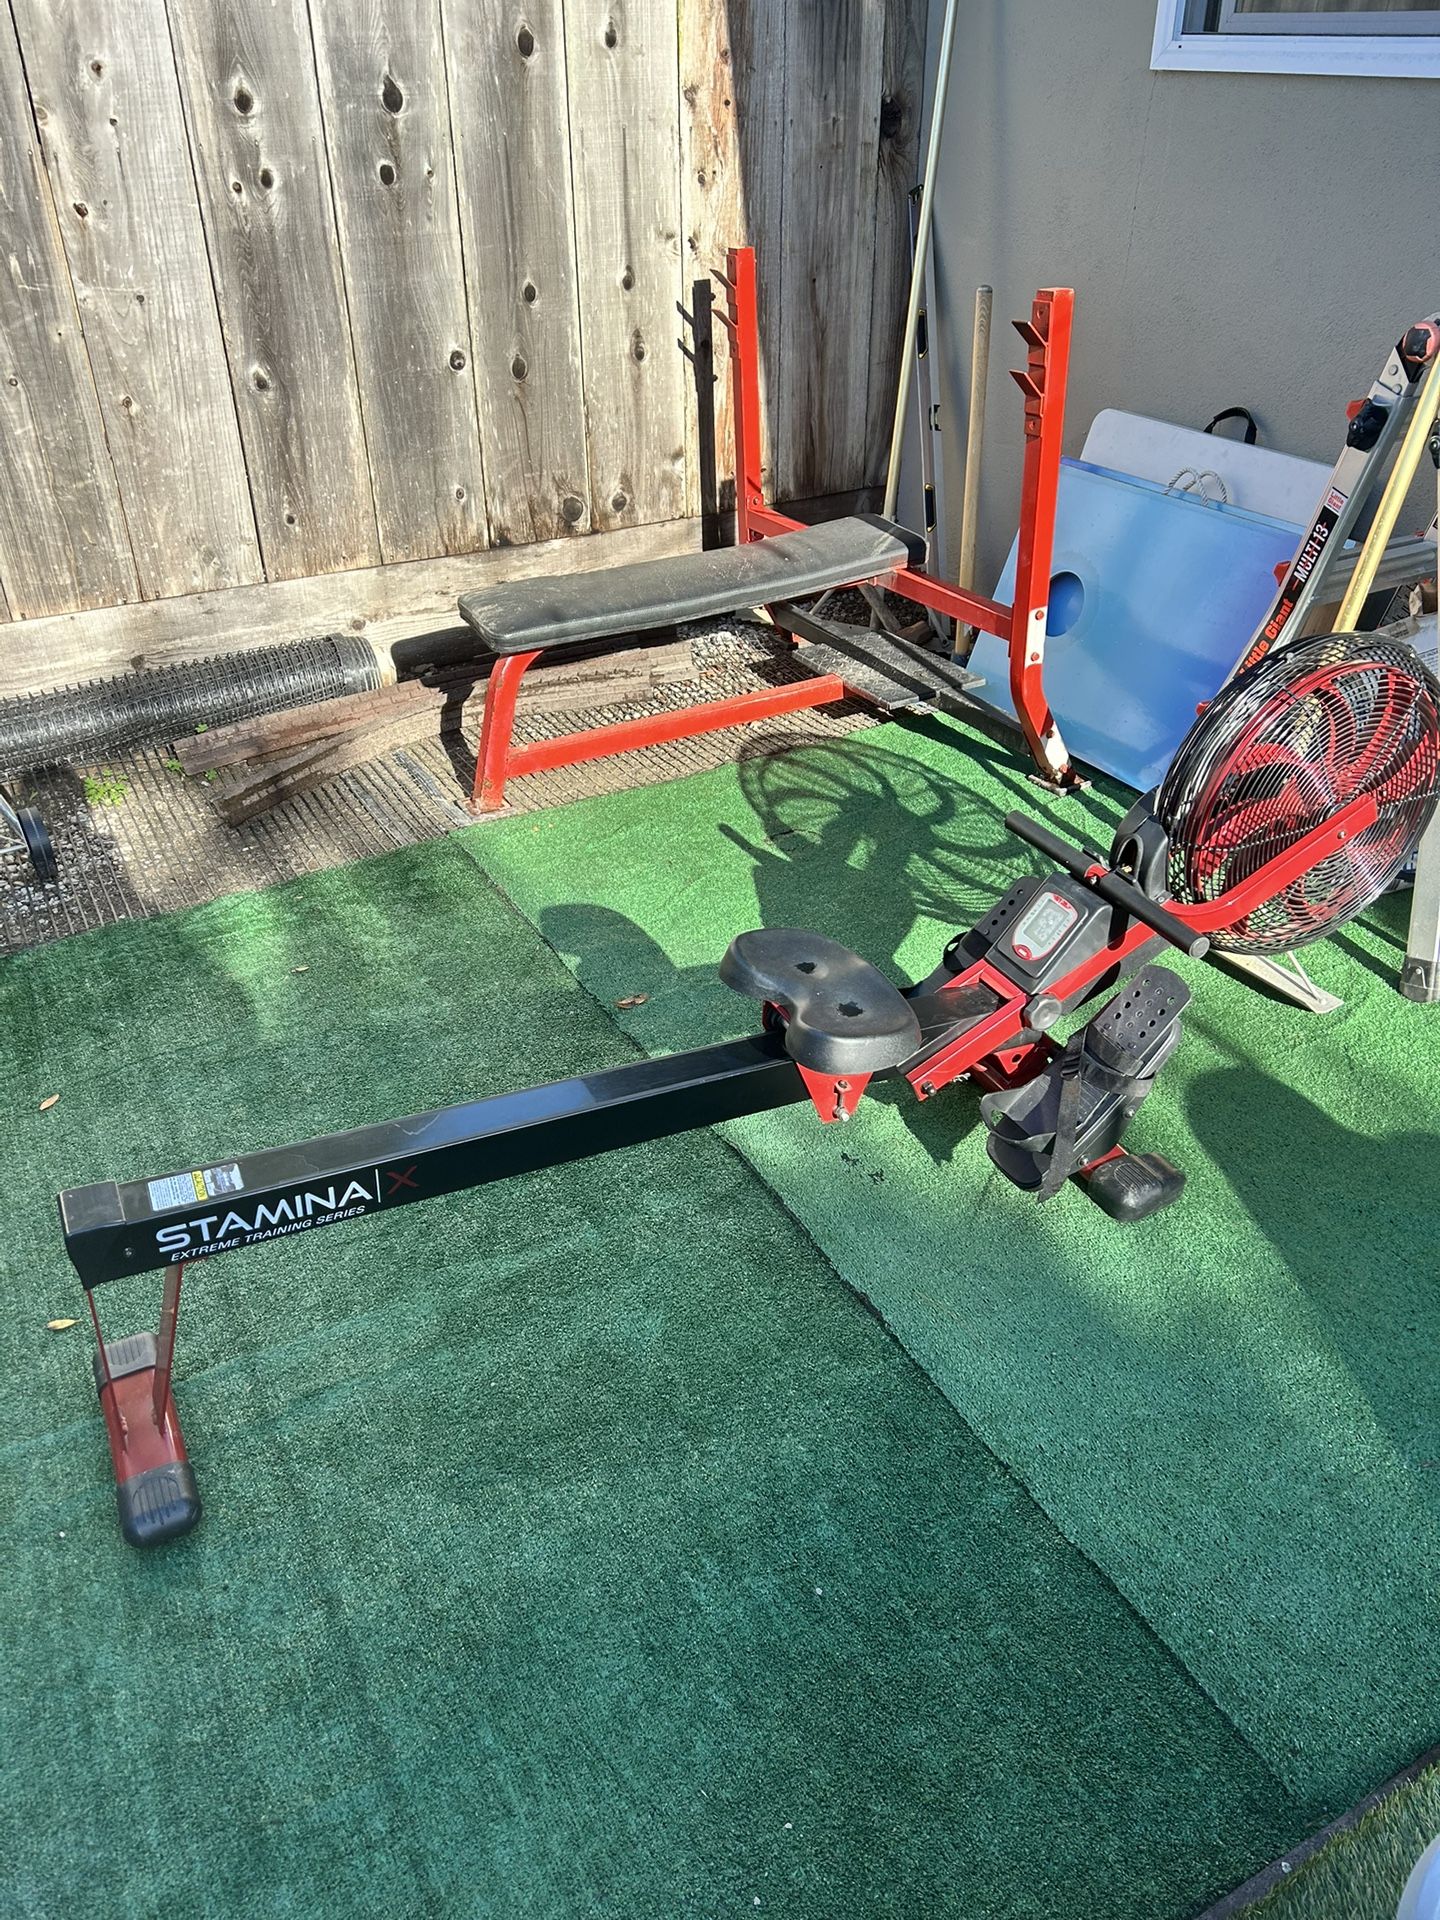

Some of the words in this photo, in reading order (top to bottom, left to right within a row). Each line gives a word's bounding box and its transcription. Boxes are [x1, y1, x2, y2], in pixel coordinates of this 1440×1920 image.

[1293, 540, 1321, 583] MULTI
[1312, 523, 1329, 542] 13
[1239, 639, 1270, 674] ittle
[1264, 598, 1294, 640] Giant
[155, 1180, 374, 1253] STAMINA
[171, 1237, 240, 1262] EXTREME
[245, 1219, 312, 1243] TRAINING
[316, 1205, 366, 1226] SERIES
